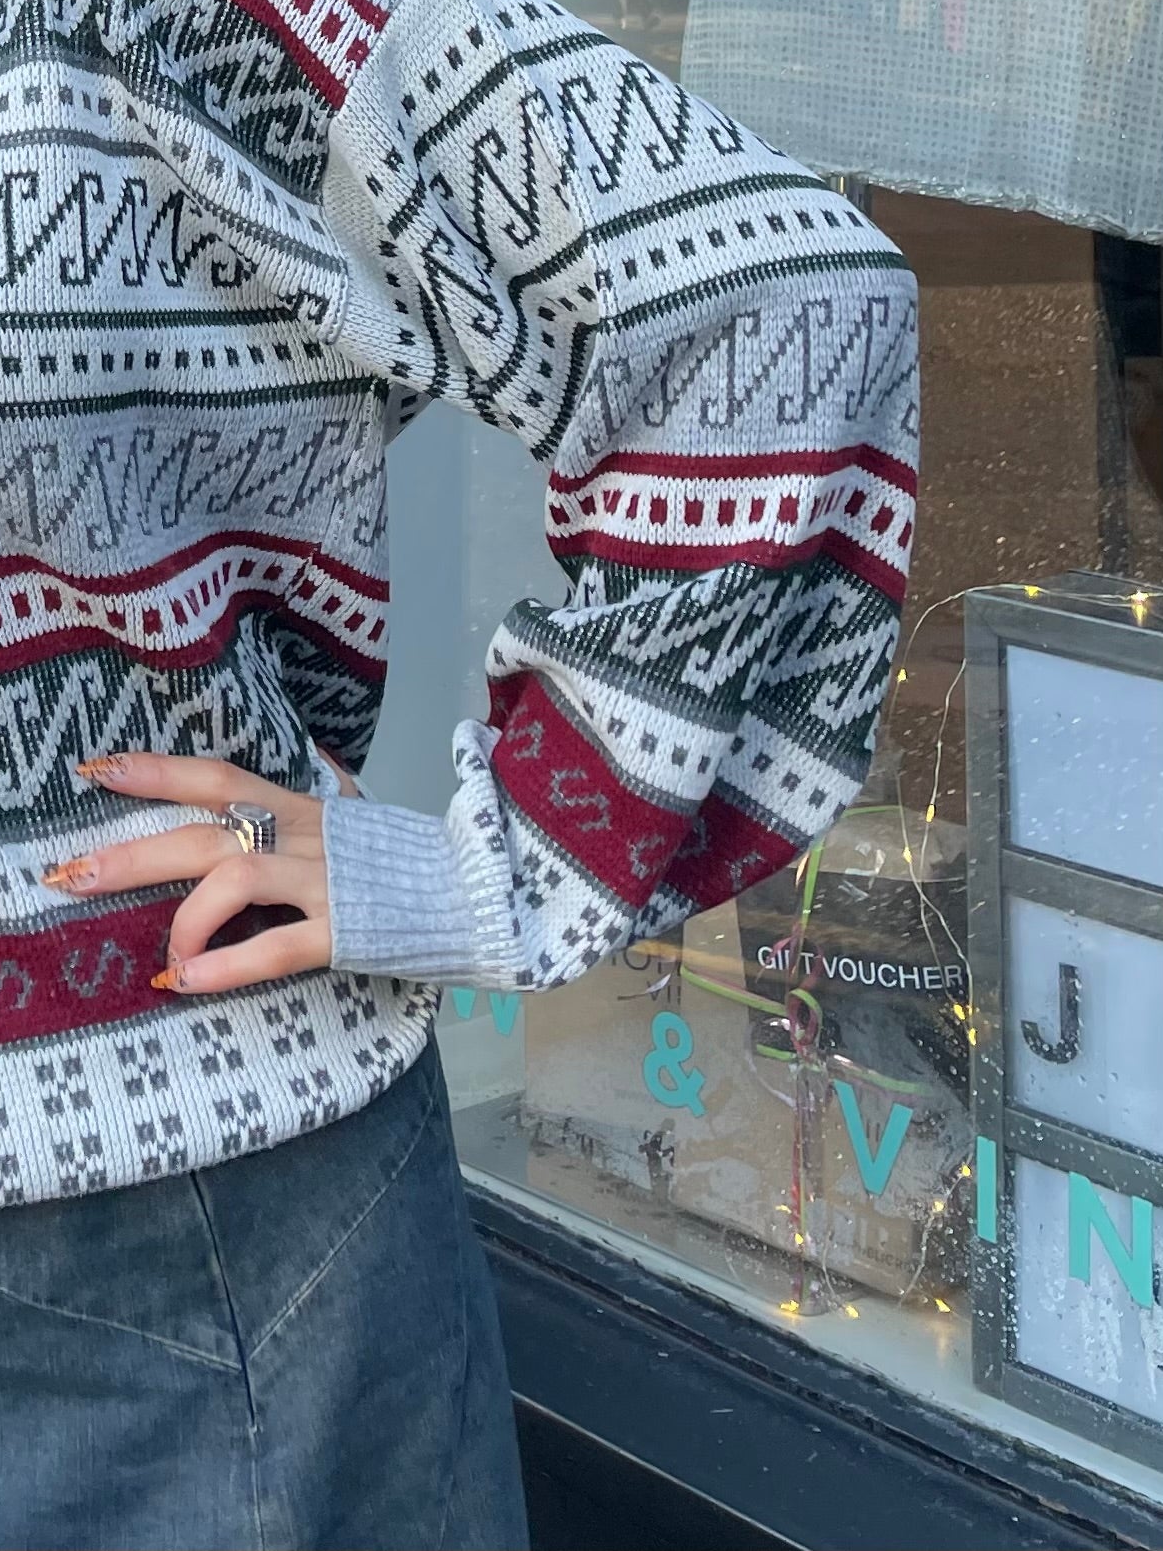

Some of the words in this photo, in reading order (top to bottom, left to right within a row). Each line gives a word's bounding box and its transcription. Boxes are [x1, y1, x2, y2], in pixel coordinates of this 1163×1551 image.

[822, 956, 963, 990] VOUCHER
[1020, 962, 1082, 1065] J
[643, 1010, 706, 1118] &
